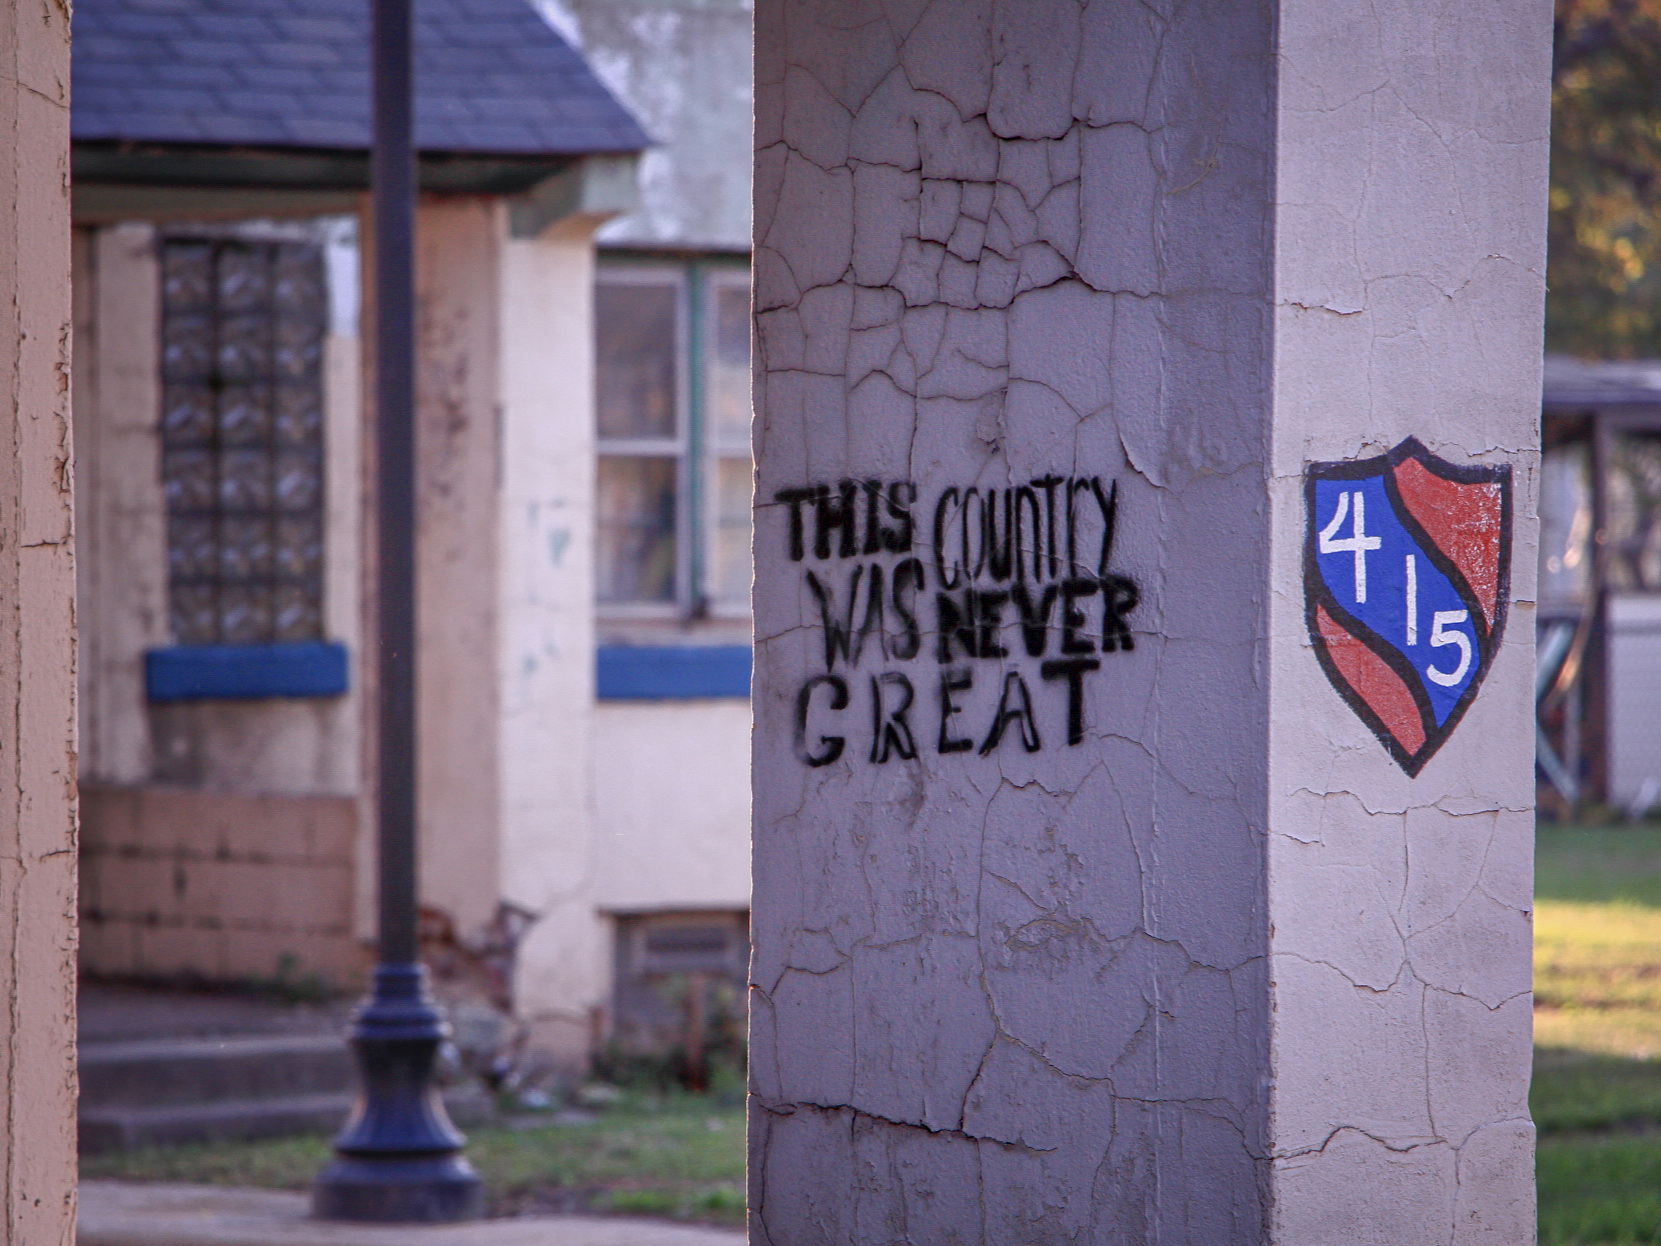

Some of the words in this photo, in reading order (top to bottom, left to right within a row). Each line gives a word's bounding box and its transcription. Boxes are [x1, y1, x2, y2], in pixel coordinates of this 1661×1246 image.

[776, 478, 915, 561] THIS
[807, 559, 924, 672] WAS
[937, 575, 1138, 663] NEVER
[797, 660, 1099, 767] GREAT
